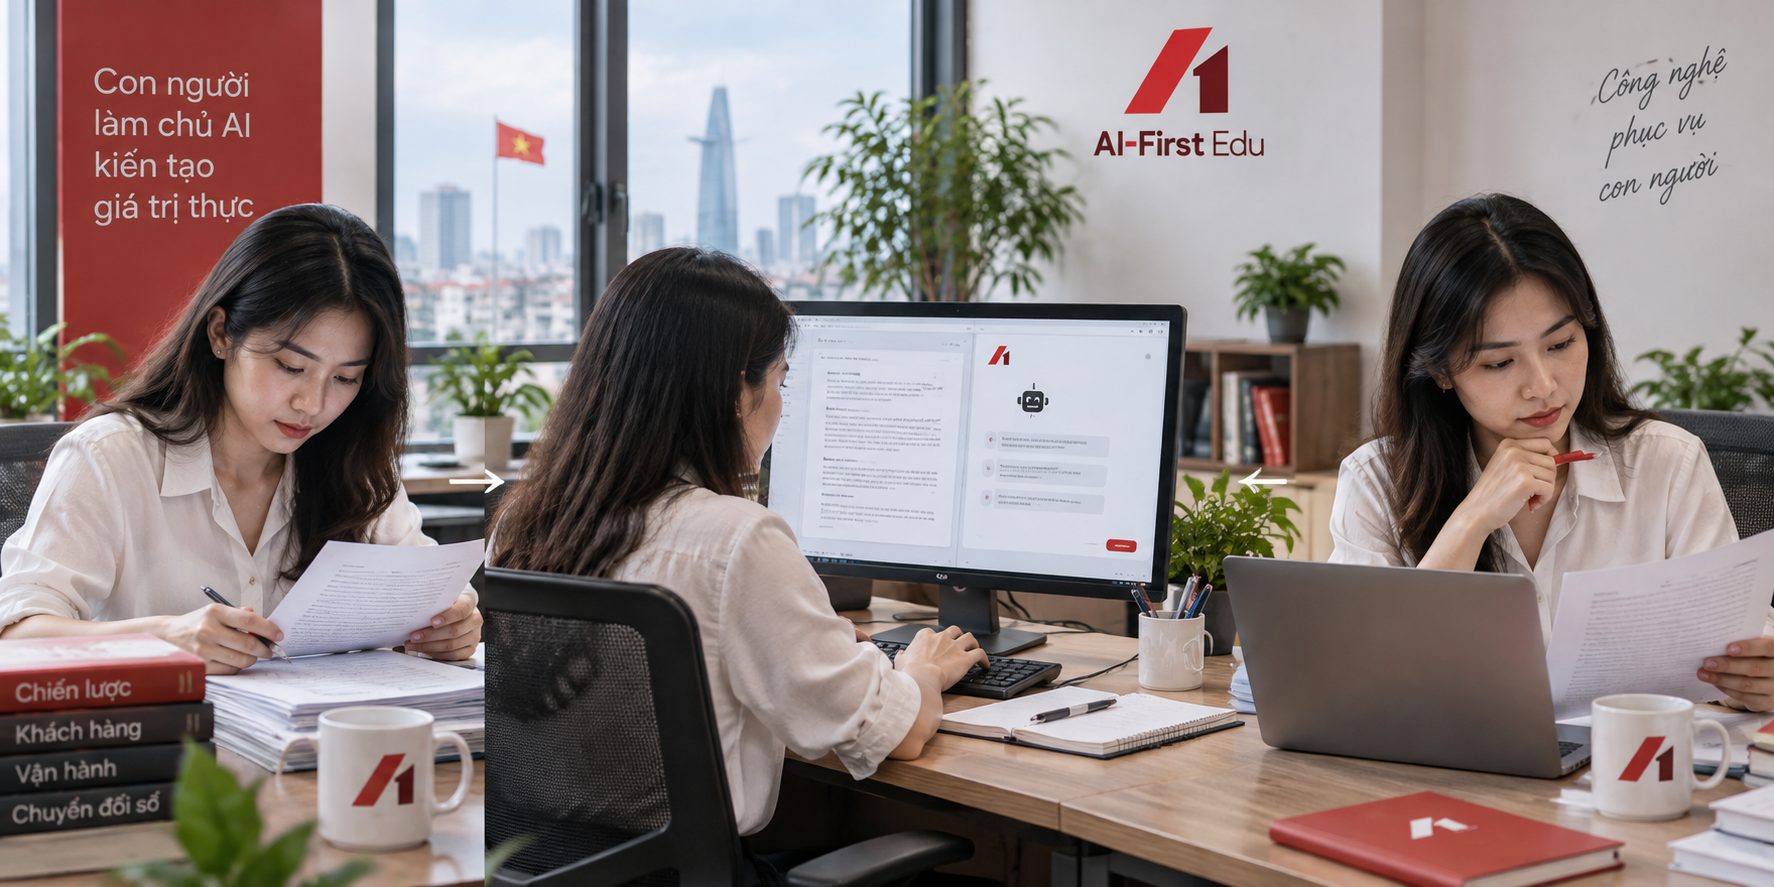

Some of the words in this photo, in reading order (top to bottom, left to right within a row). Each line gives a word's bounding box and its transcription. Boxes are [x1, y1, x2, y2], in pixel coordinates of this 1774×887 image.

[94, 67, 157, 95] Con
[167, 71, 249, 103] người
[1598, 68, 1660, 111] Công
[1668, 45, 1728, 100] nghệ
[95, 108, 148, 136] làm
[158, 110, 213, 137] chủ
[221, 112, 251, 138] AI
[1093, 130, 1205, 157] AI-First
[1212, 130, 1265, 157] Edu
[1604, 115, 1668, 169] phục
[1678, 113, 1706, 135] vụ
[95, 148, 157, 178] kiến
[166, 154, 215, 183] tạo
[1599, 178, 1642, 202] con
[1649, 151, 1719, 205] người
[94, 193, 139, 227] giá
[148, 193, 179, 224] trị
[188, 192, 254, 223] thực
[15, 678, 79, 703] Chiến
[85, 679, 132, 701] lược
[15, 720, 83, 745] Khách
[89, 718, 142, 746] hàng
[15, 763, 58, 787] Vận
[64, 758, 117, 781] hành
